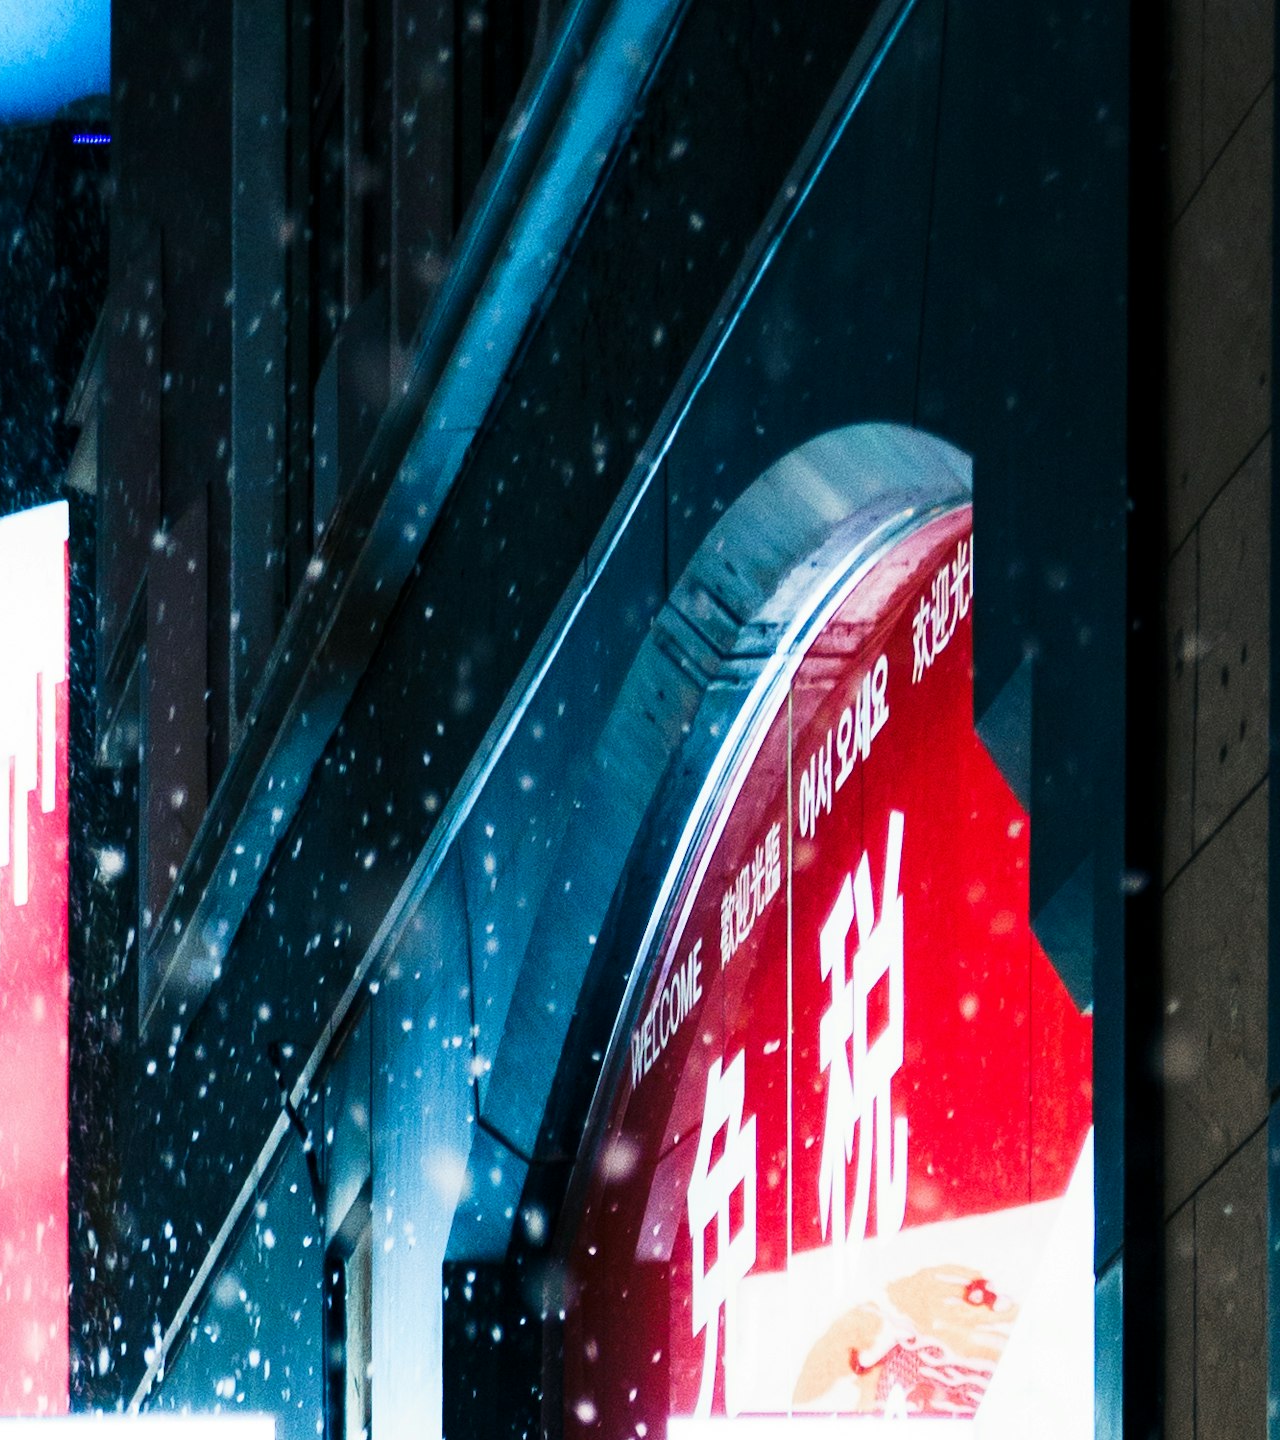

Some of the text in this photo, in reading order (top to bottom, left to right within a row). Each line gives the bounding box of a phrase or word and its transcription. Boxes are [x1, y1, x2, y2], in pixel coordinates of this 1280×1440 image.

[911, 532, 973, 685] 欢迎光
[631, 937, 704, 1091] WELCOME
